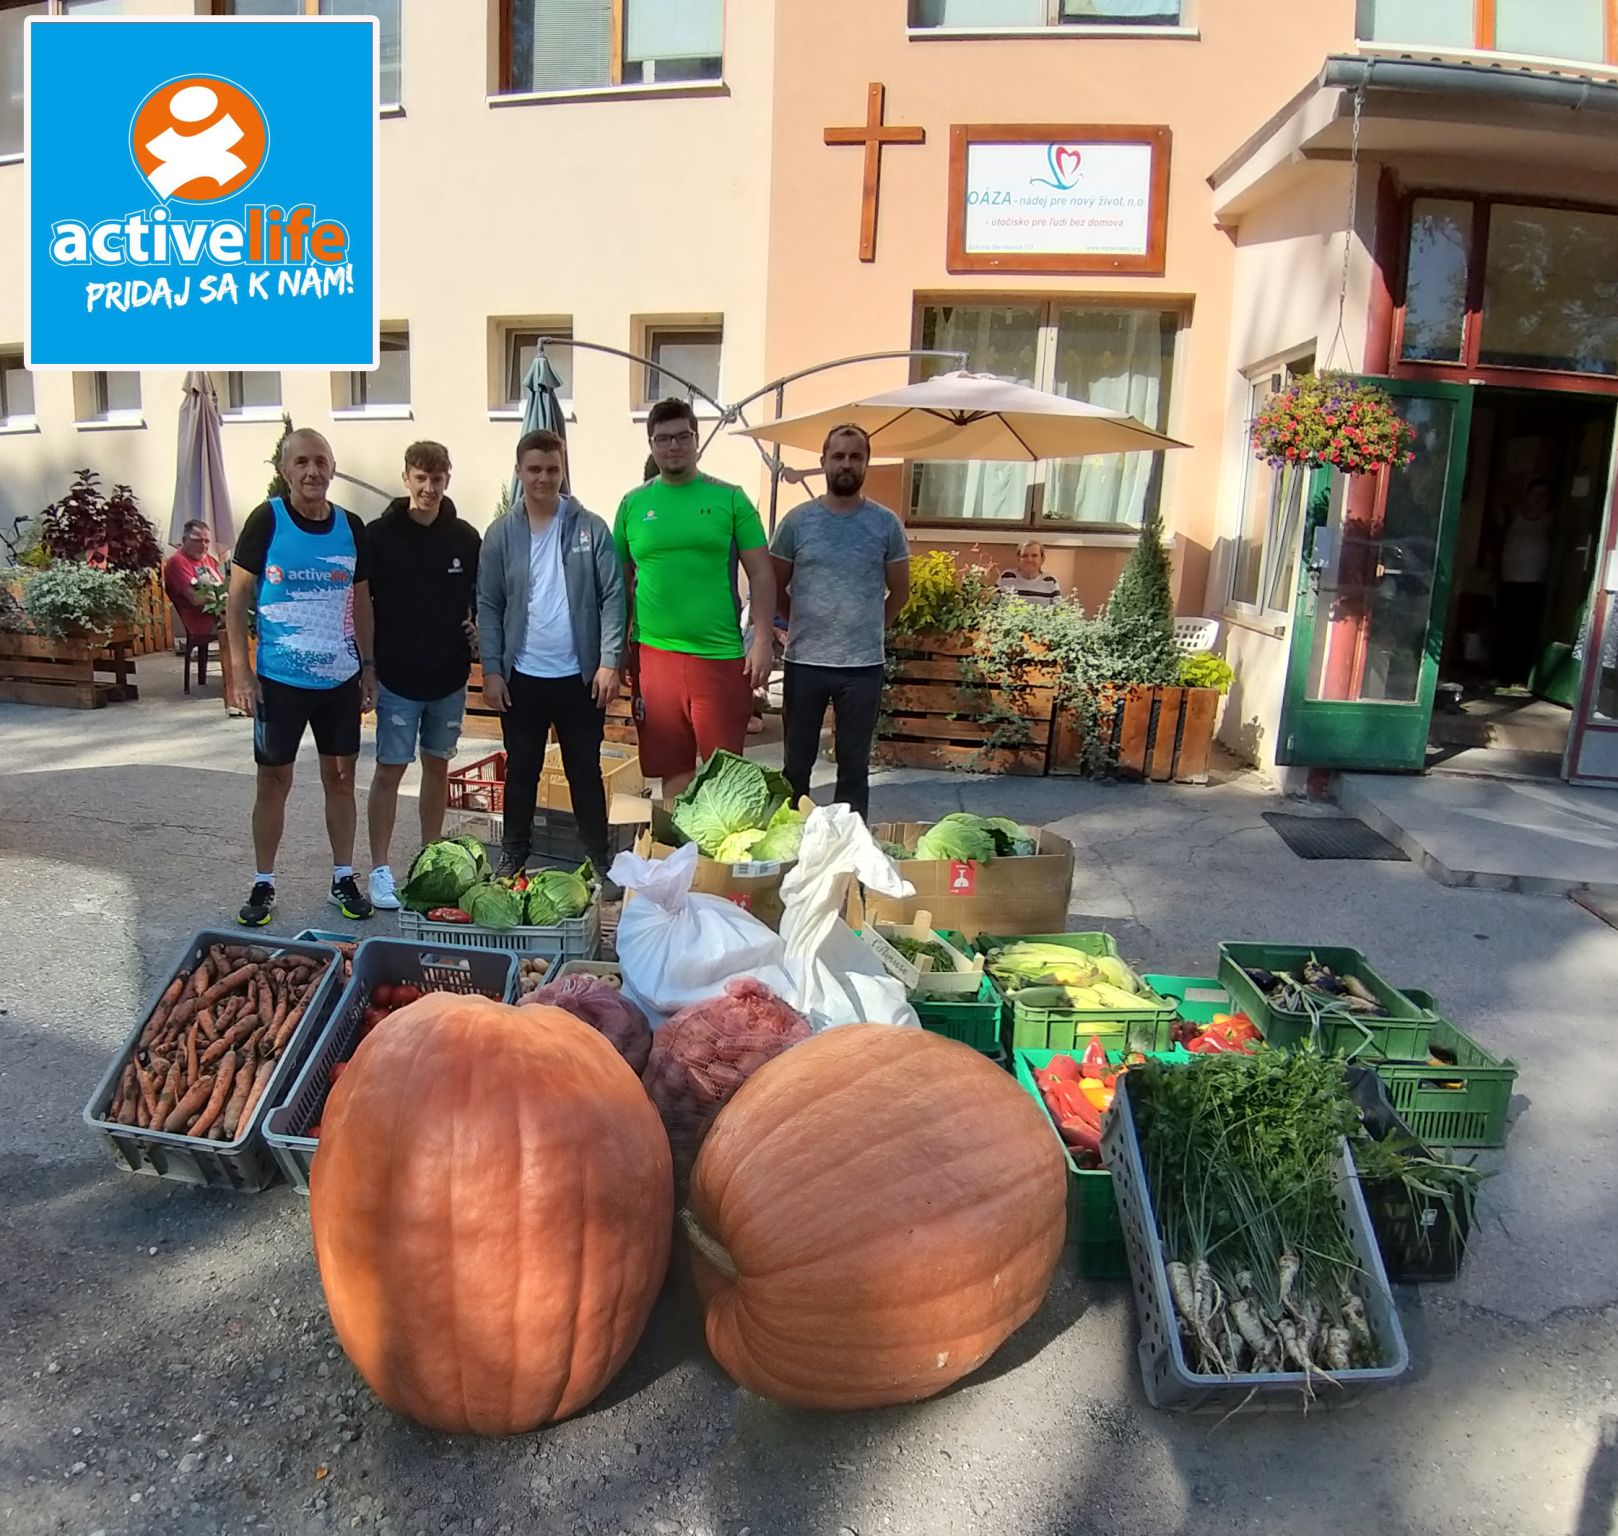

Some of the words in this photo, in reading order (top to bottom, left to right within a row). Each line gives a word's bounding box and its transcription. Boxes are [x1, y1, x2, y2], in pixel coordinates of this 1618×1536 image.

[968, 187, 1011, 205] OÁZA
[1050, 197, 1067, 208] pre
[1070, 195, 1096, 208] nový
[1031, 218, 1047, 228] pre
[1069, 217, 1085, 227] bez
[1087, 217, 1124, 227] domova
